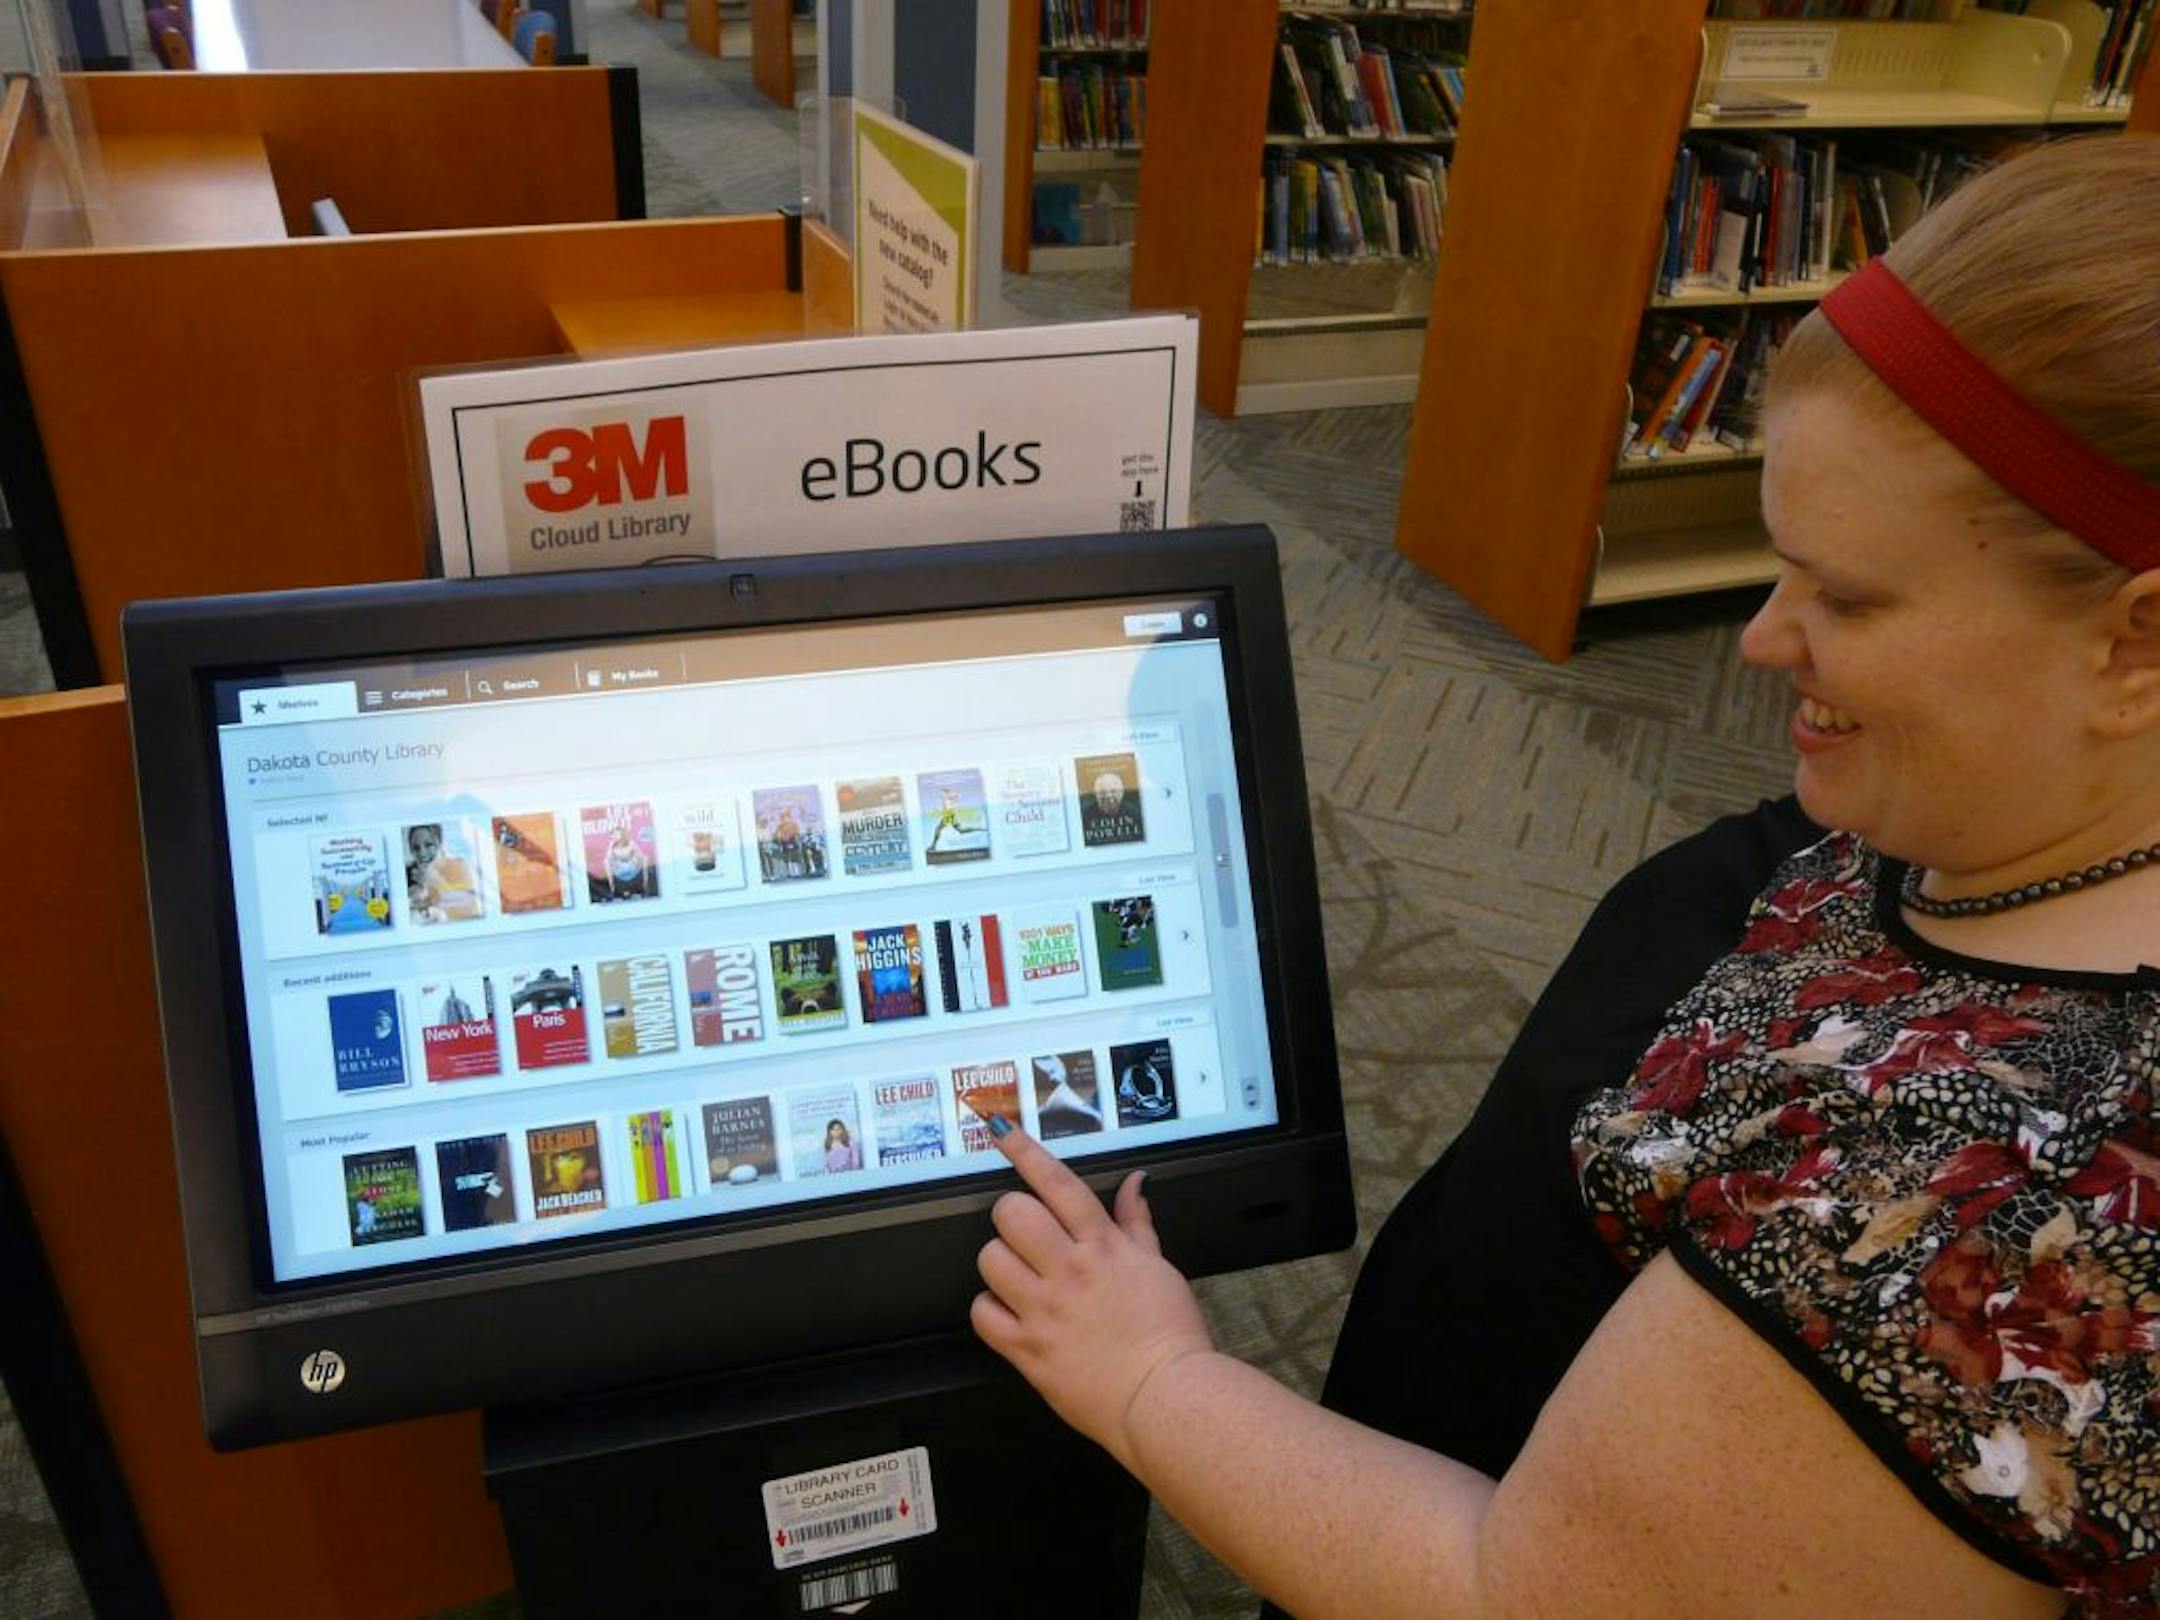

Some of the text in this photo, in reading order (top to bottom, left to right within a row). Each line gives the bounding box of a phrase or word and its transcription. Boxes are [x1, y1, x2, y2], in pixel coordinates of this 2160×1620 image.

[889, 214, 907, 241] help
[911, 232, 930, 254] with
[932, 241, 948, 266] the
[524, 415, 689, 513] 3M
[801, 430, 1042, 501] eBooks
[530, 511, 692, 551] Cloud Library
[391, 686, 449, 702] Categories
[503, 677, 540, 691] Search
[247, 741, 446, 774] Dakota County Library
[842, 813, 904, 835] MURDER
[869, 933, 907, 953] JACK
[857, 945, 923, 971] HIGGINS
[1022, 949, 1077, 968] MONEY
[284, 975, 321, 987] Recent
[714, 943, 763, 1042] ROME
[627, 955, 677, 1055] CALIFORNIA
[425, 1021, 494, 1043] New York
[532, 1012, 568, 1029] Paris
[338, 1047, 374, 1061] BILL
[338, 1055, 401, 1073] BRYSON
[954, 1065, 1014, 1092] LEE CHILD
[875, 1079, 935, 1106] LEE CHILD
[711, 1106, 762, 1125] JULIAN
[711, 1118, 766, 1135] BARNES
[329, 1132, 370, 1145] Popular
[305, 1350, 341, 1393] hp
[785, 1458, 900, 1495] LIBRARY CARD
[800, 1482, 877, 1510] SCANNER
